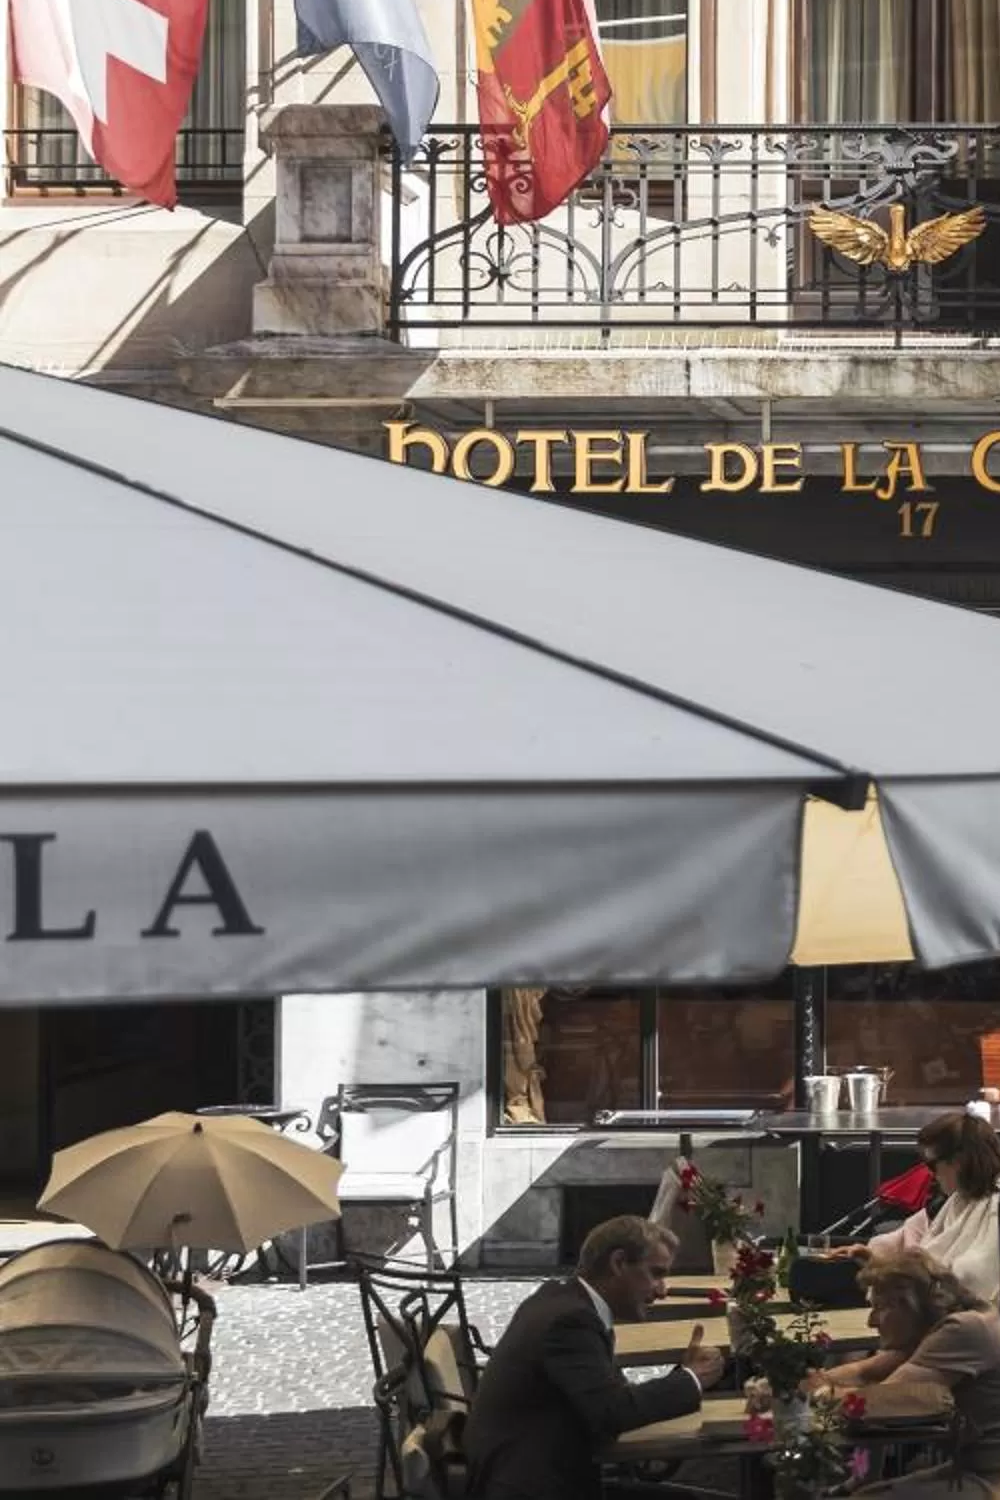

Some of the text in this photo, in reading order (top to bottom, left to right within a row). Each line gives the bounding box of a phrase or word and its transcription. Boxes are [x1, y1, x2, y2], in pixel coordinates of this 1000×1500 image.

[382, 419, 675, 494] HOTEL
[700, 441, 805, 494] DE
[840, 440, 936, 501] LA
[897, 501, 940, 537] 17
[0, 829, 266, 942] LA
